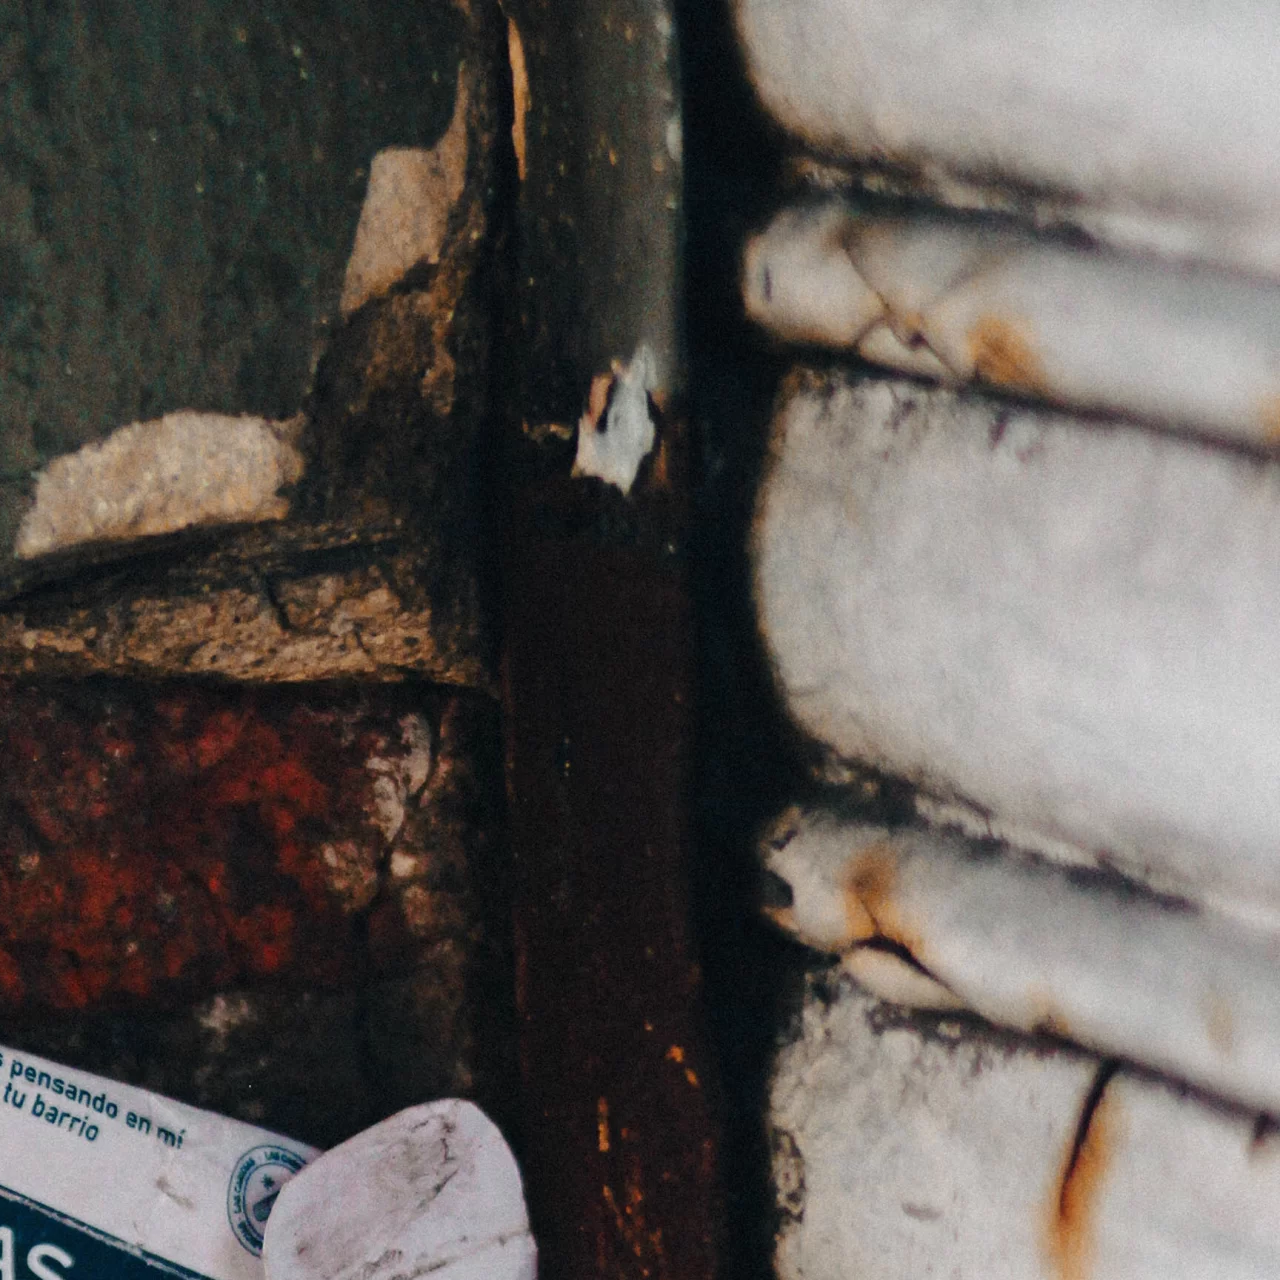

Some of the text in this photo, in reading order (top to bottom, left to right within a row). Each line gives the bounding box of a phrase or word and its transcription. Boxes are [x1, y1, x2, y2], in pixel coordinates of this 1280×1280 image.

[4, 1082, 26, 1108] tu
[32, 1094, 99, 1142] barrio
[10, 1059, 118, 1118] pensando
[125, 1111, 151, 1134] en
